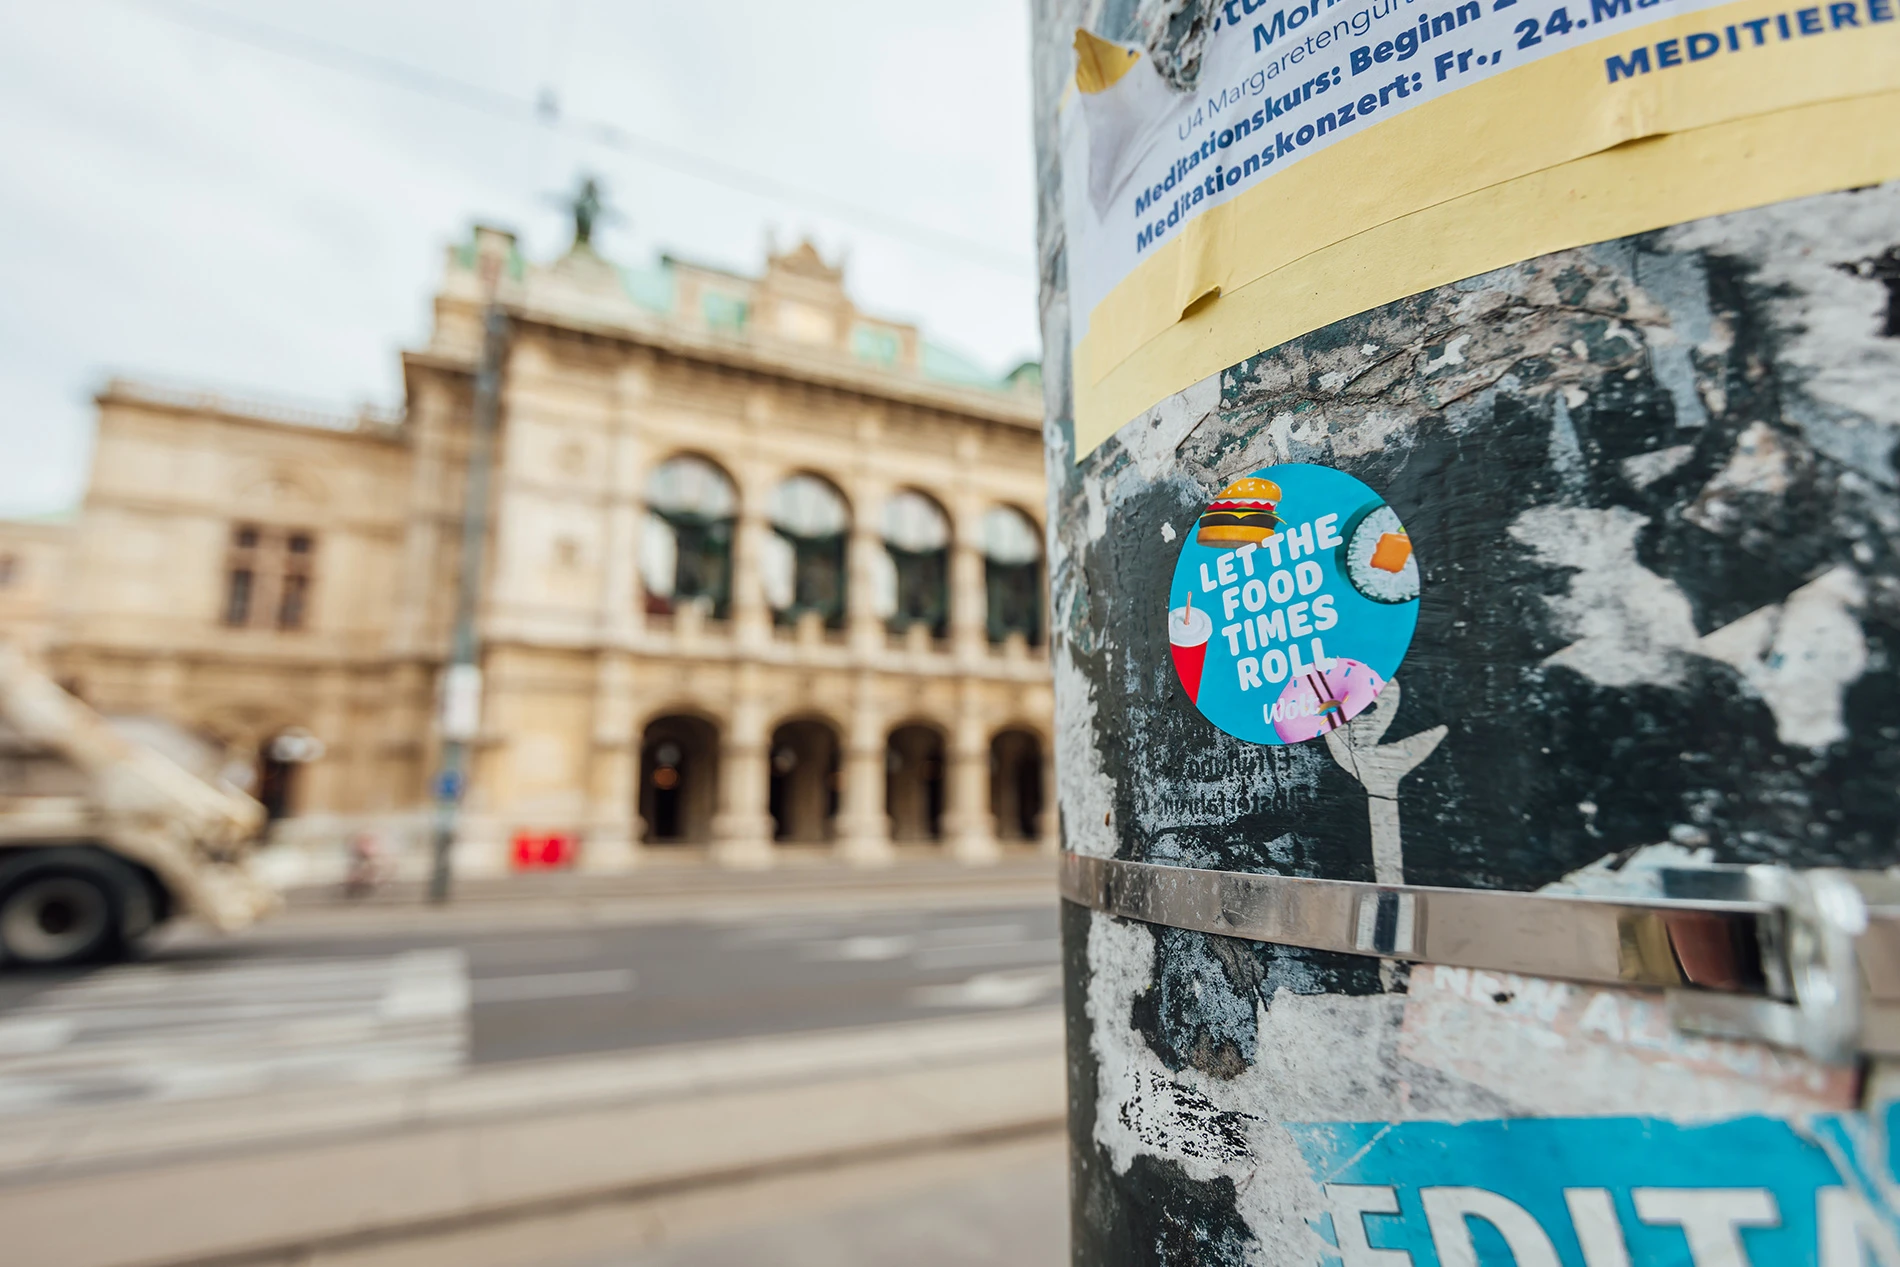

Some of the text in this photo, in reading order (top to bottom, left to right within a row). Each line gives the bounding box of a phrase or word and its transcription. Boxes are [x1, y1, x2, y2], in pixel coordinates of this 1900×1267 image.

[1135, 0, 1481, 218] Meditationskurs: Beginn
[1178, 107, 1204, 141] U4
[1136, 72, 1423, 253] Meditationskonzert:
[1434, 48, 1503, 82] Fr.,
[1200, 512, 1344, 593] LET THE
[1222, 560, 1324, 621] FOOD
[1221, 594, 1339, 656] TIMES
[1236, 637, 1339, 692] ROLL
